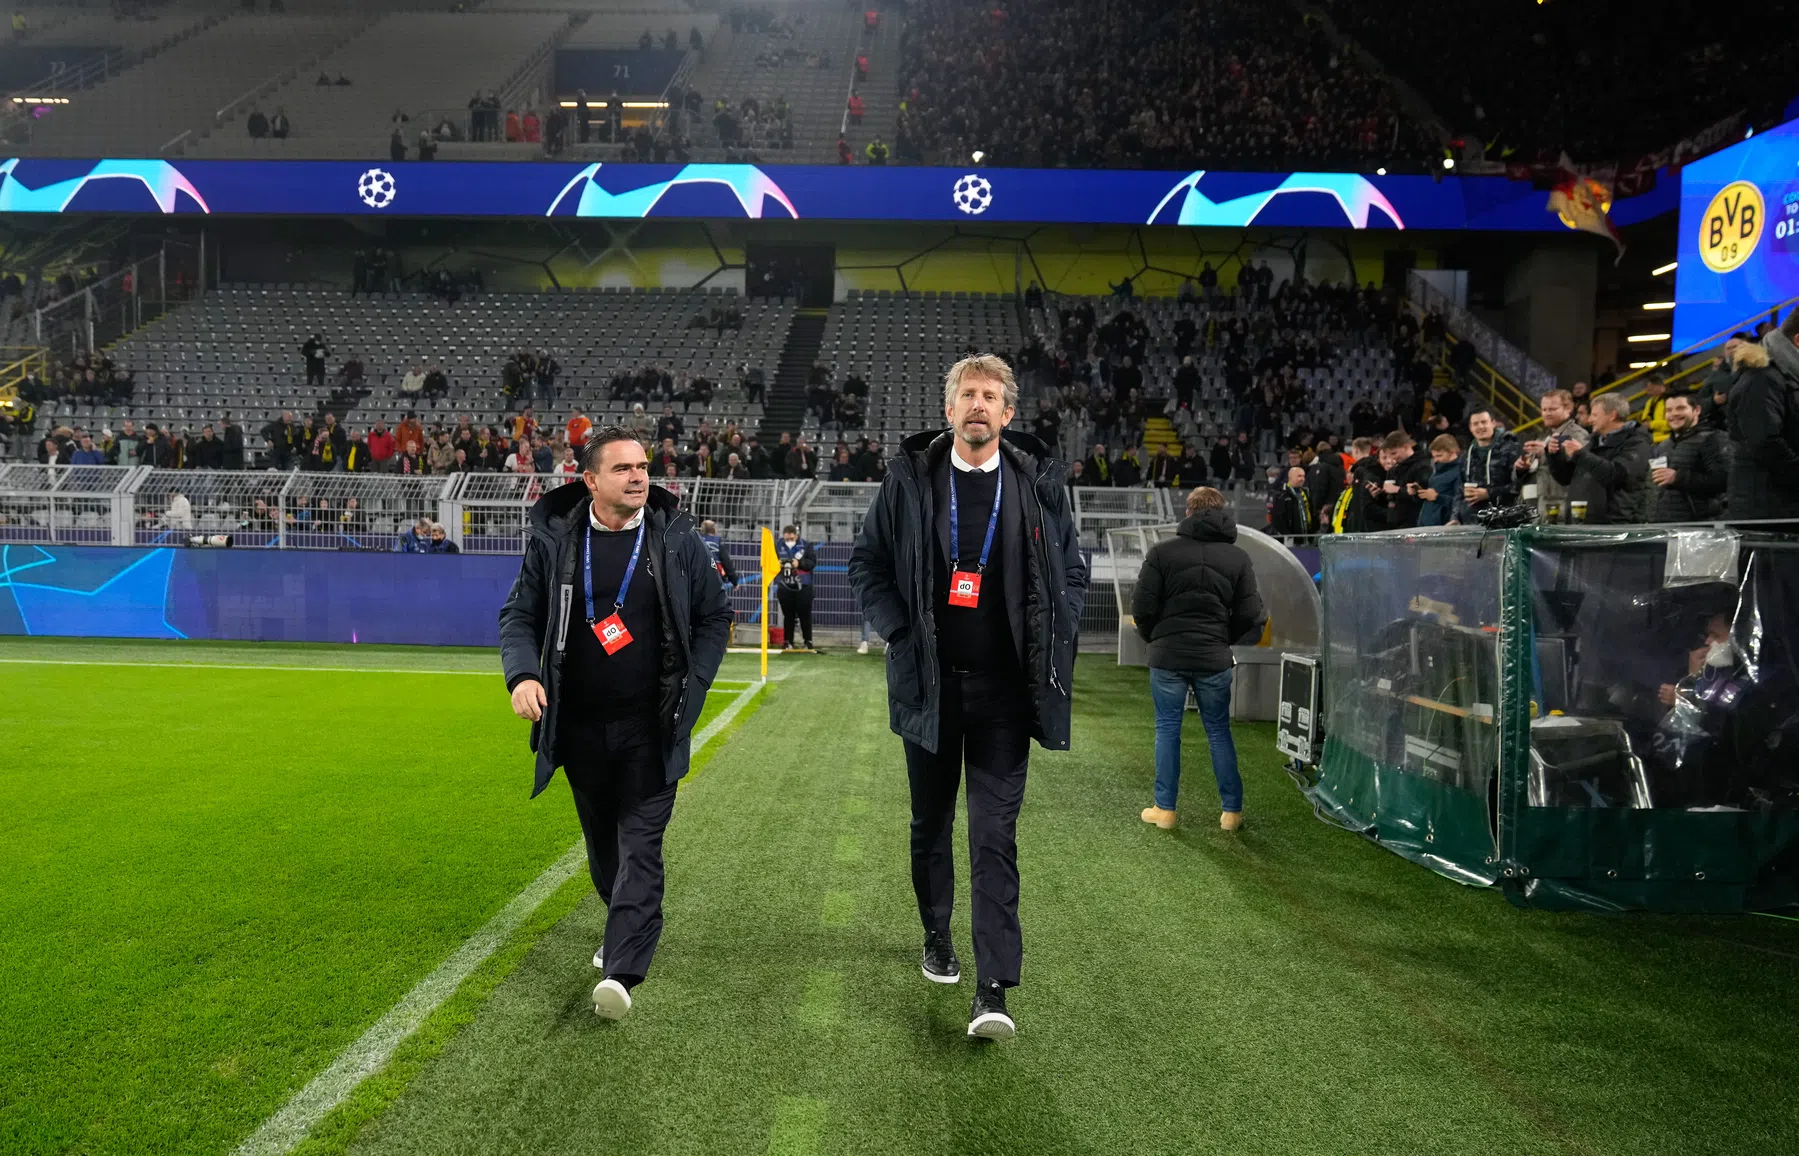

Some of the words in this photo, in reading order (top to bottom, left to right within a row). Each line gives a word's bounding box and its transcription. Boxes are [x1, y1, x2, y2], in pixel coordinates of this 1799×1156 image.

[612, 65, 630, 78] 71
[1710, 192, 1755, 249] BVB
[1721, 243, 1738, 262] 09
